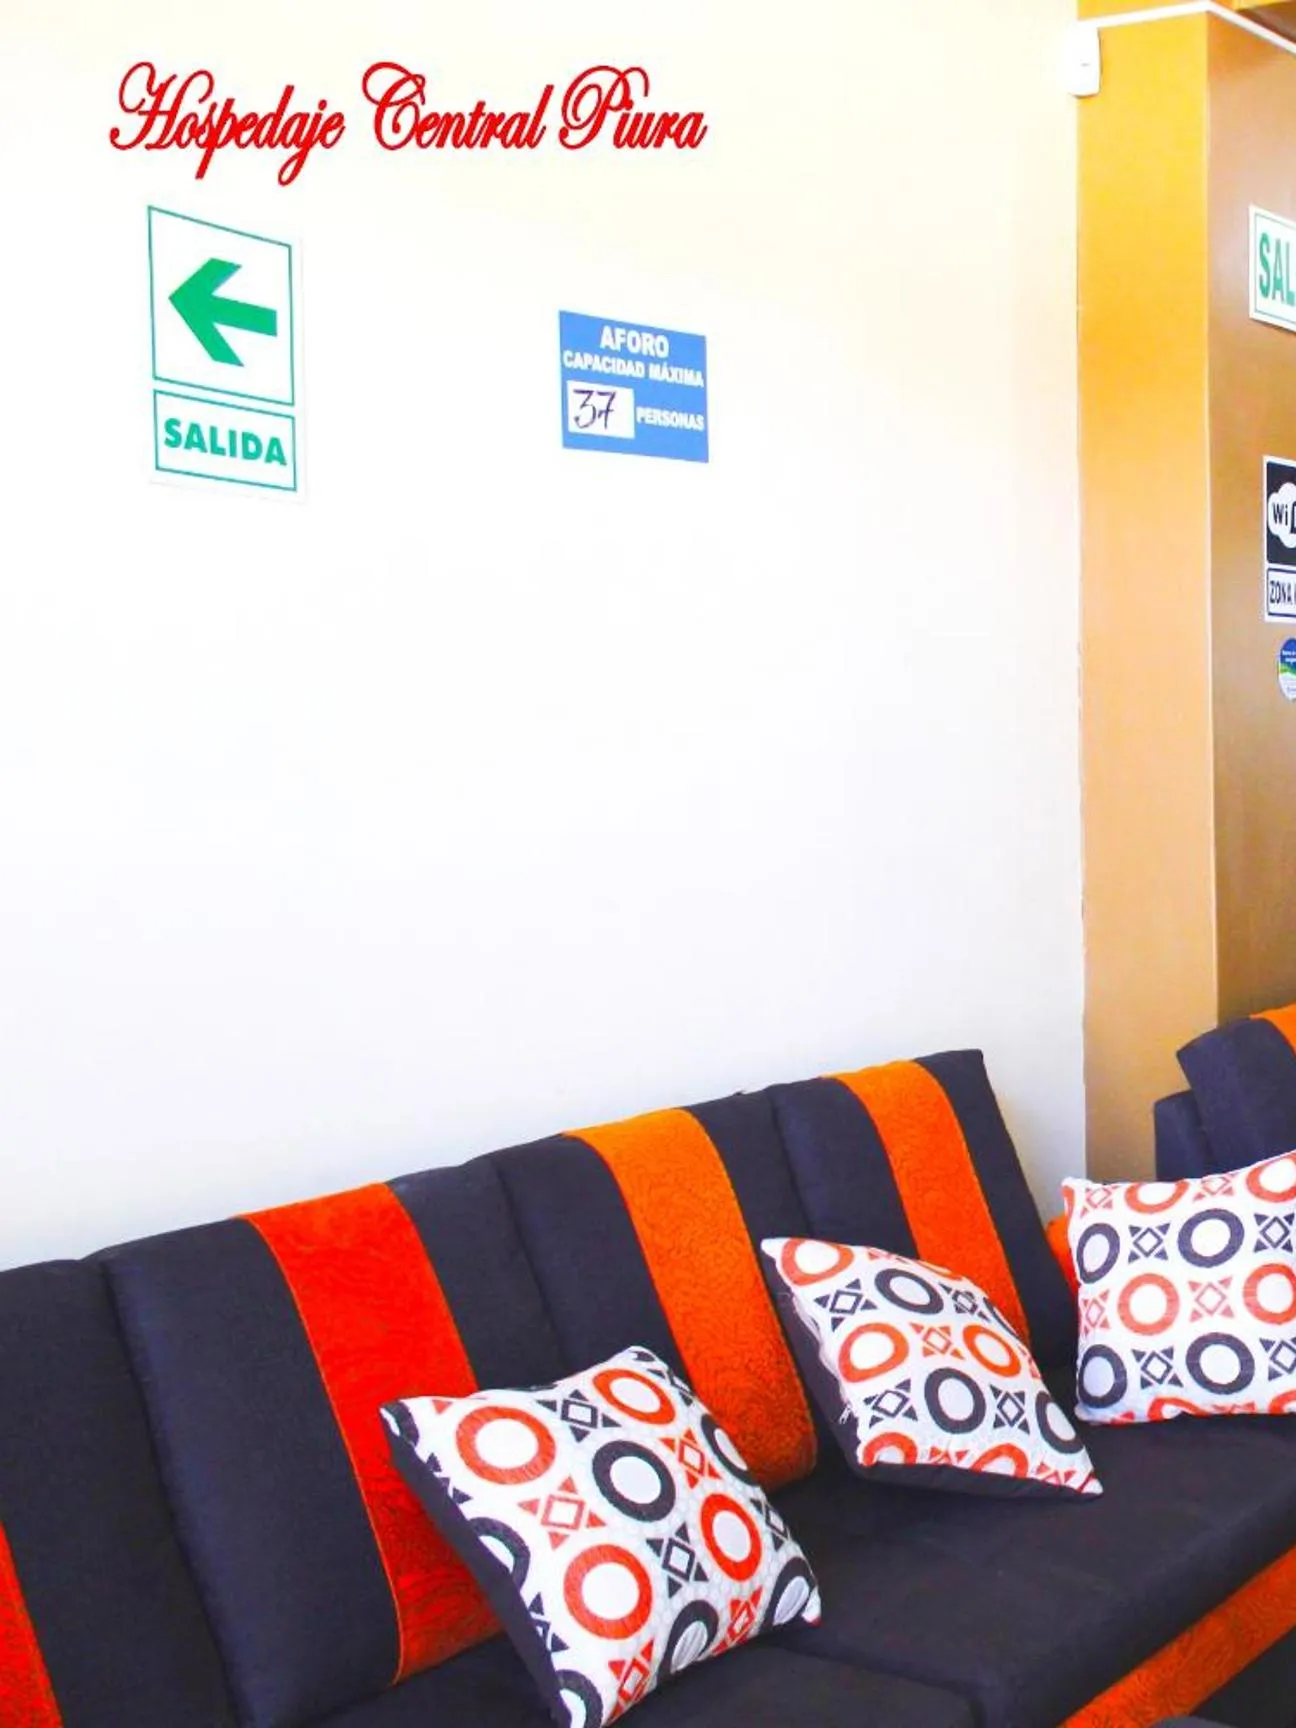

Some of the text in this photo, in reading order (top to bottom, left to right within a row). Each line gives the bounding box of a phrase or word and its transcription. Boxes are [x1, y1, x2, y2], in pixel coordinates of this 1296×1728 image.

[600, 325, 670, 358] AFORO
[563, 350, 705, 388] CAPACIDAD MÁXIMA
[573, 388, 617, 430] 37
[637, 407, 705, 432] PERSONAS
[163, 416, 288, 466] SALIDA
[1269, 580, 1293, 605] ZONA
